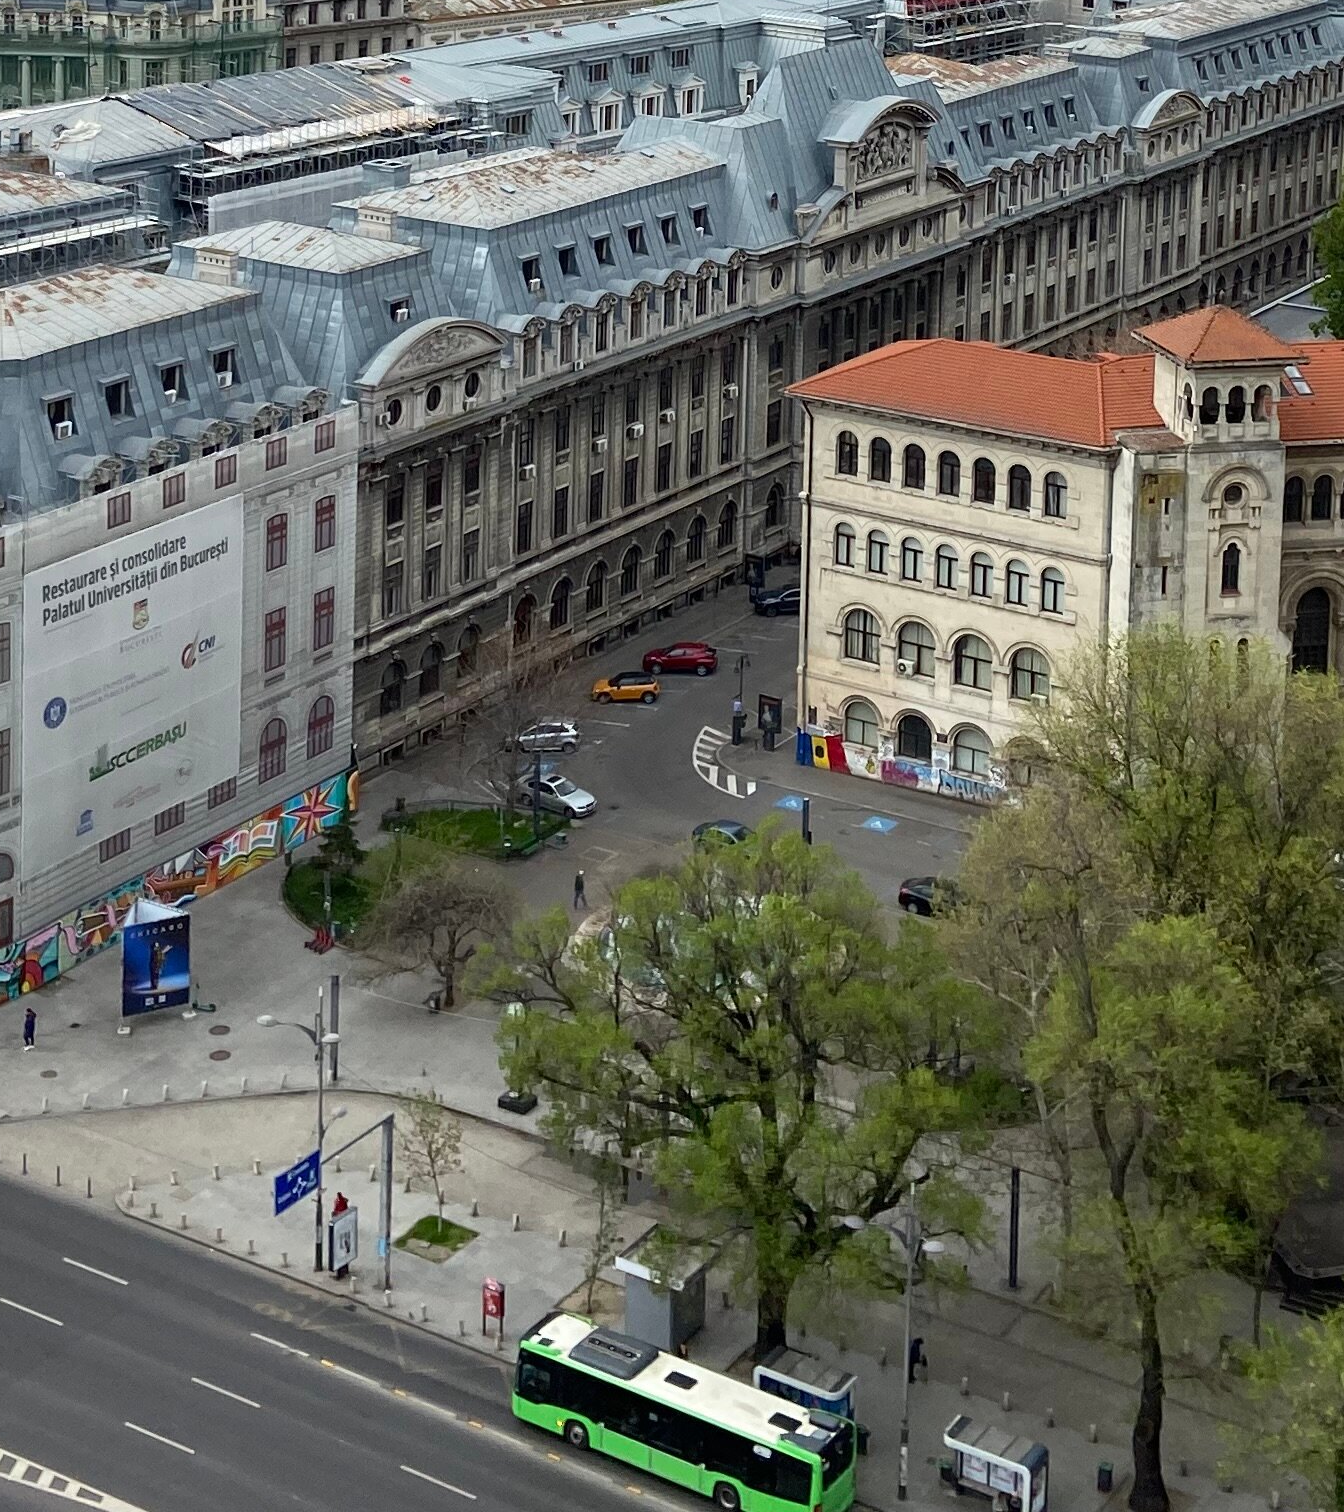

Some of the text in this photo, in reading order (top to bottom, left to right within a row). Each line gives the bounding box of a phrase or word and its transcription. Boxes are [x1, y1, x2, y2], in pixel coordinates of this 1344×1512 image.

[42, 566, 107, 604] Restaurare
[122, 535, 187, 572] consolidare
[42, 594, 85, 626] Palatul
[88, 565, 158, 609] Universității
[160, 559, 178, 581] din
[180, 536, 229, 573] București
[198, 635, 216, 653] CNI
[130, 922, 184, 939] CHICAGO
